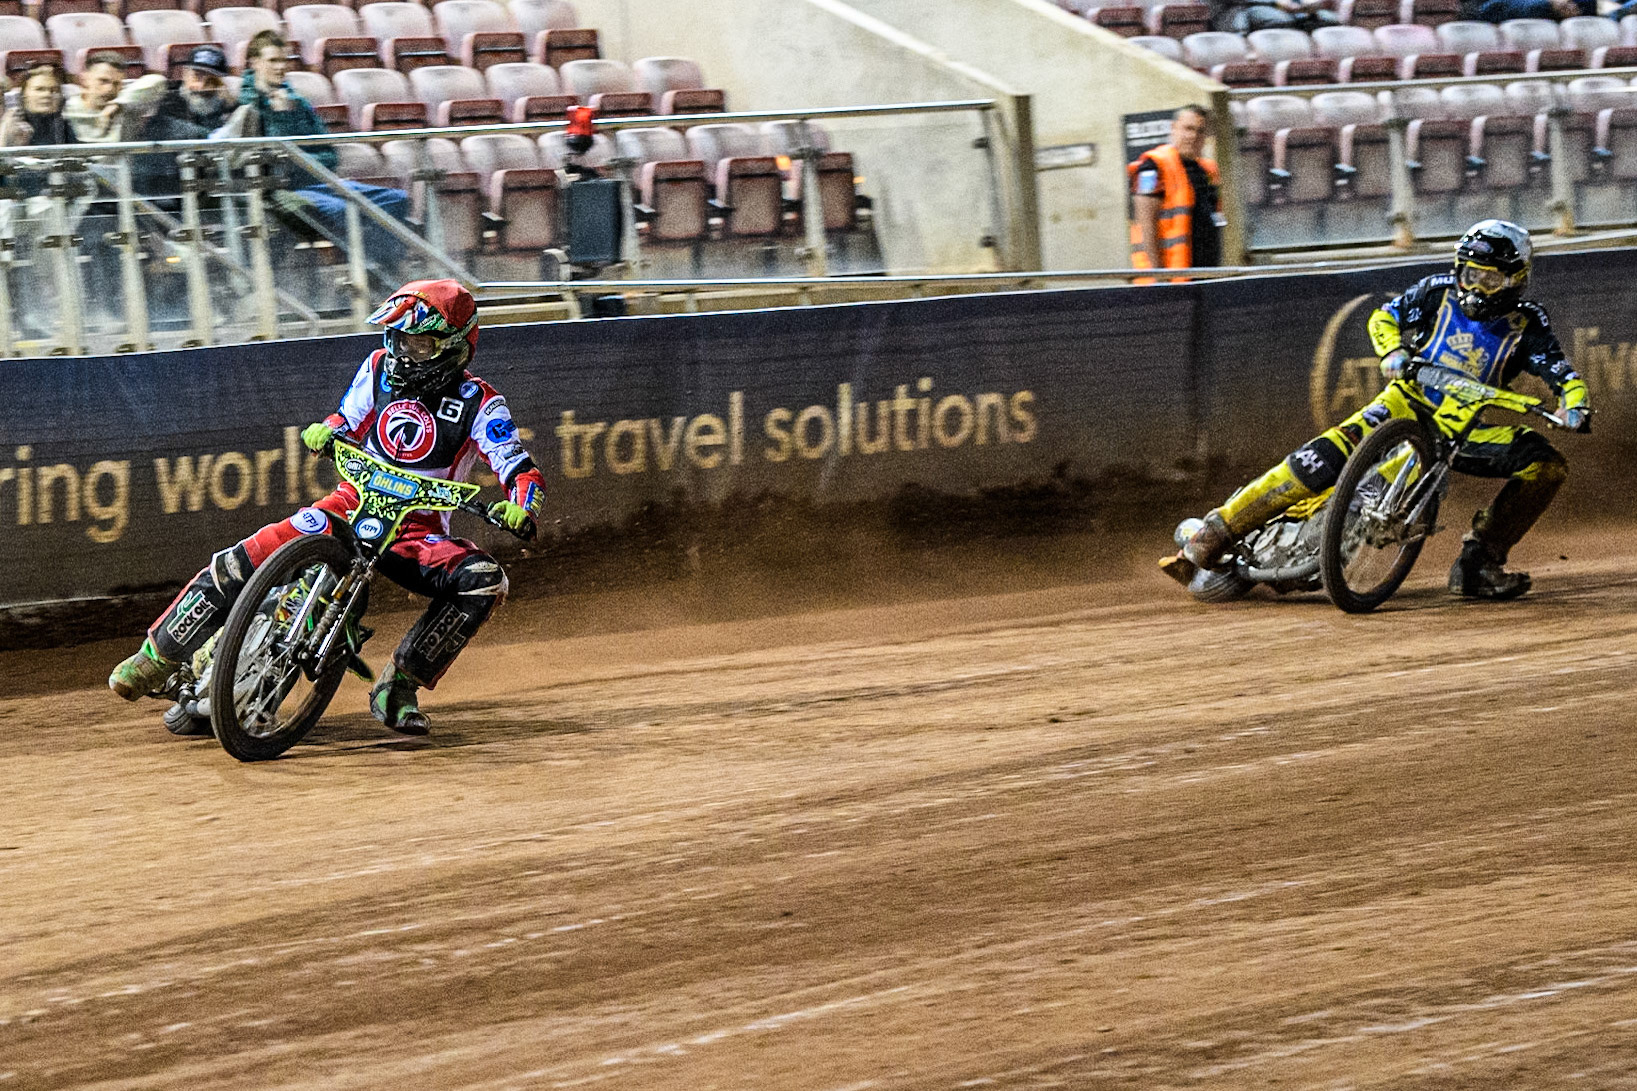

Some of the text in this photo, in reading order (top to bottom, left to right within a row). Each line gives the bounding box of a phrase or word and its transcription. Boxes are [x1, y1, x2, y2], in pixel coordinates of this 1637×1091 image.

[386, 402, 408, 416] BELLE
[420, 410, 433, 434] COLTS
[555, 390, 744, 479] travel
[763, 376, 1037, 463] solutions
[361, 523, 379, 534] ATPI
[171, 599, 211, 640] ROCK OIL
